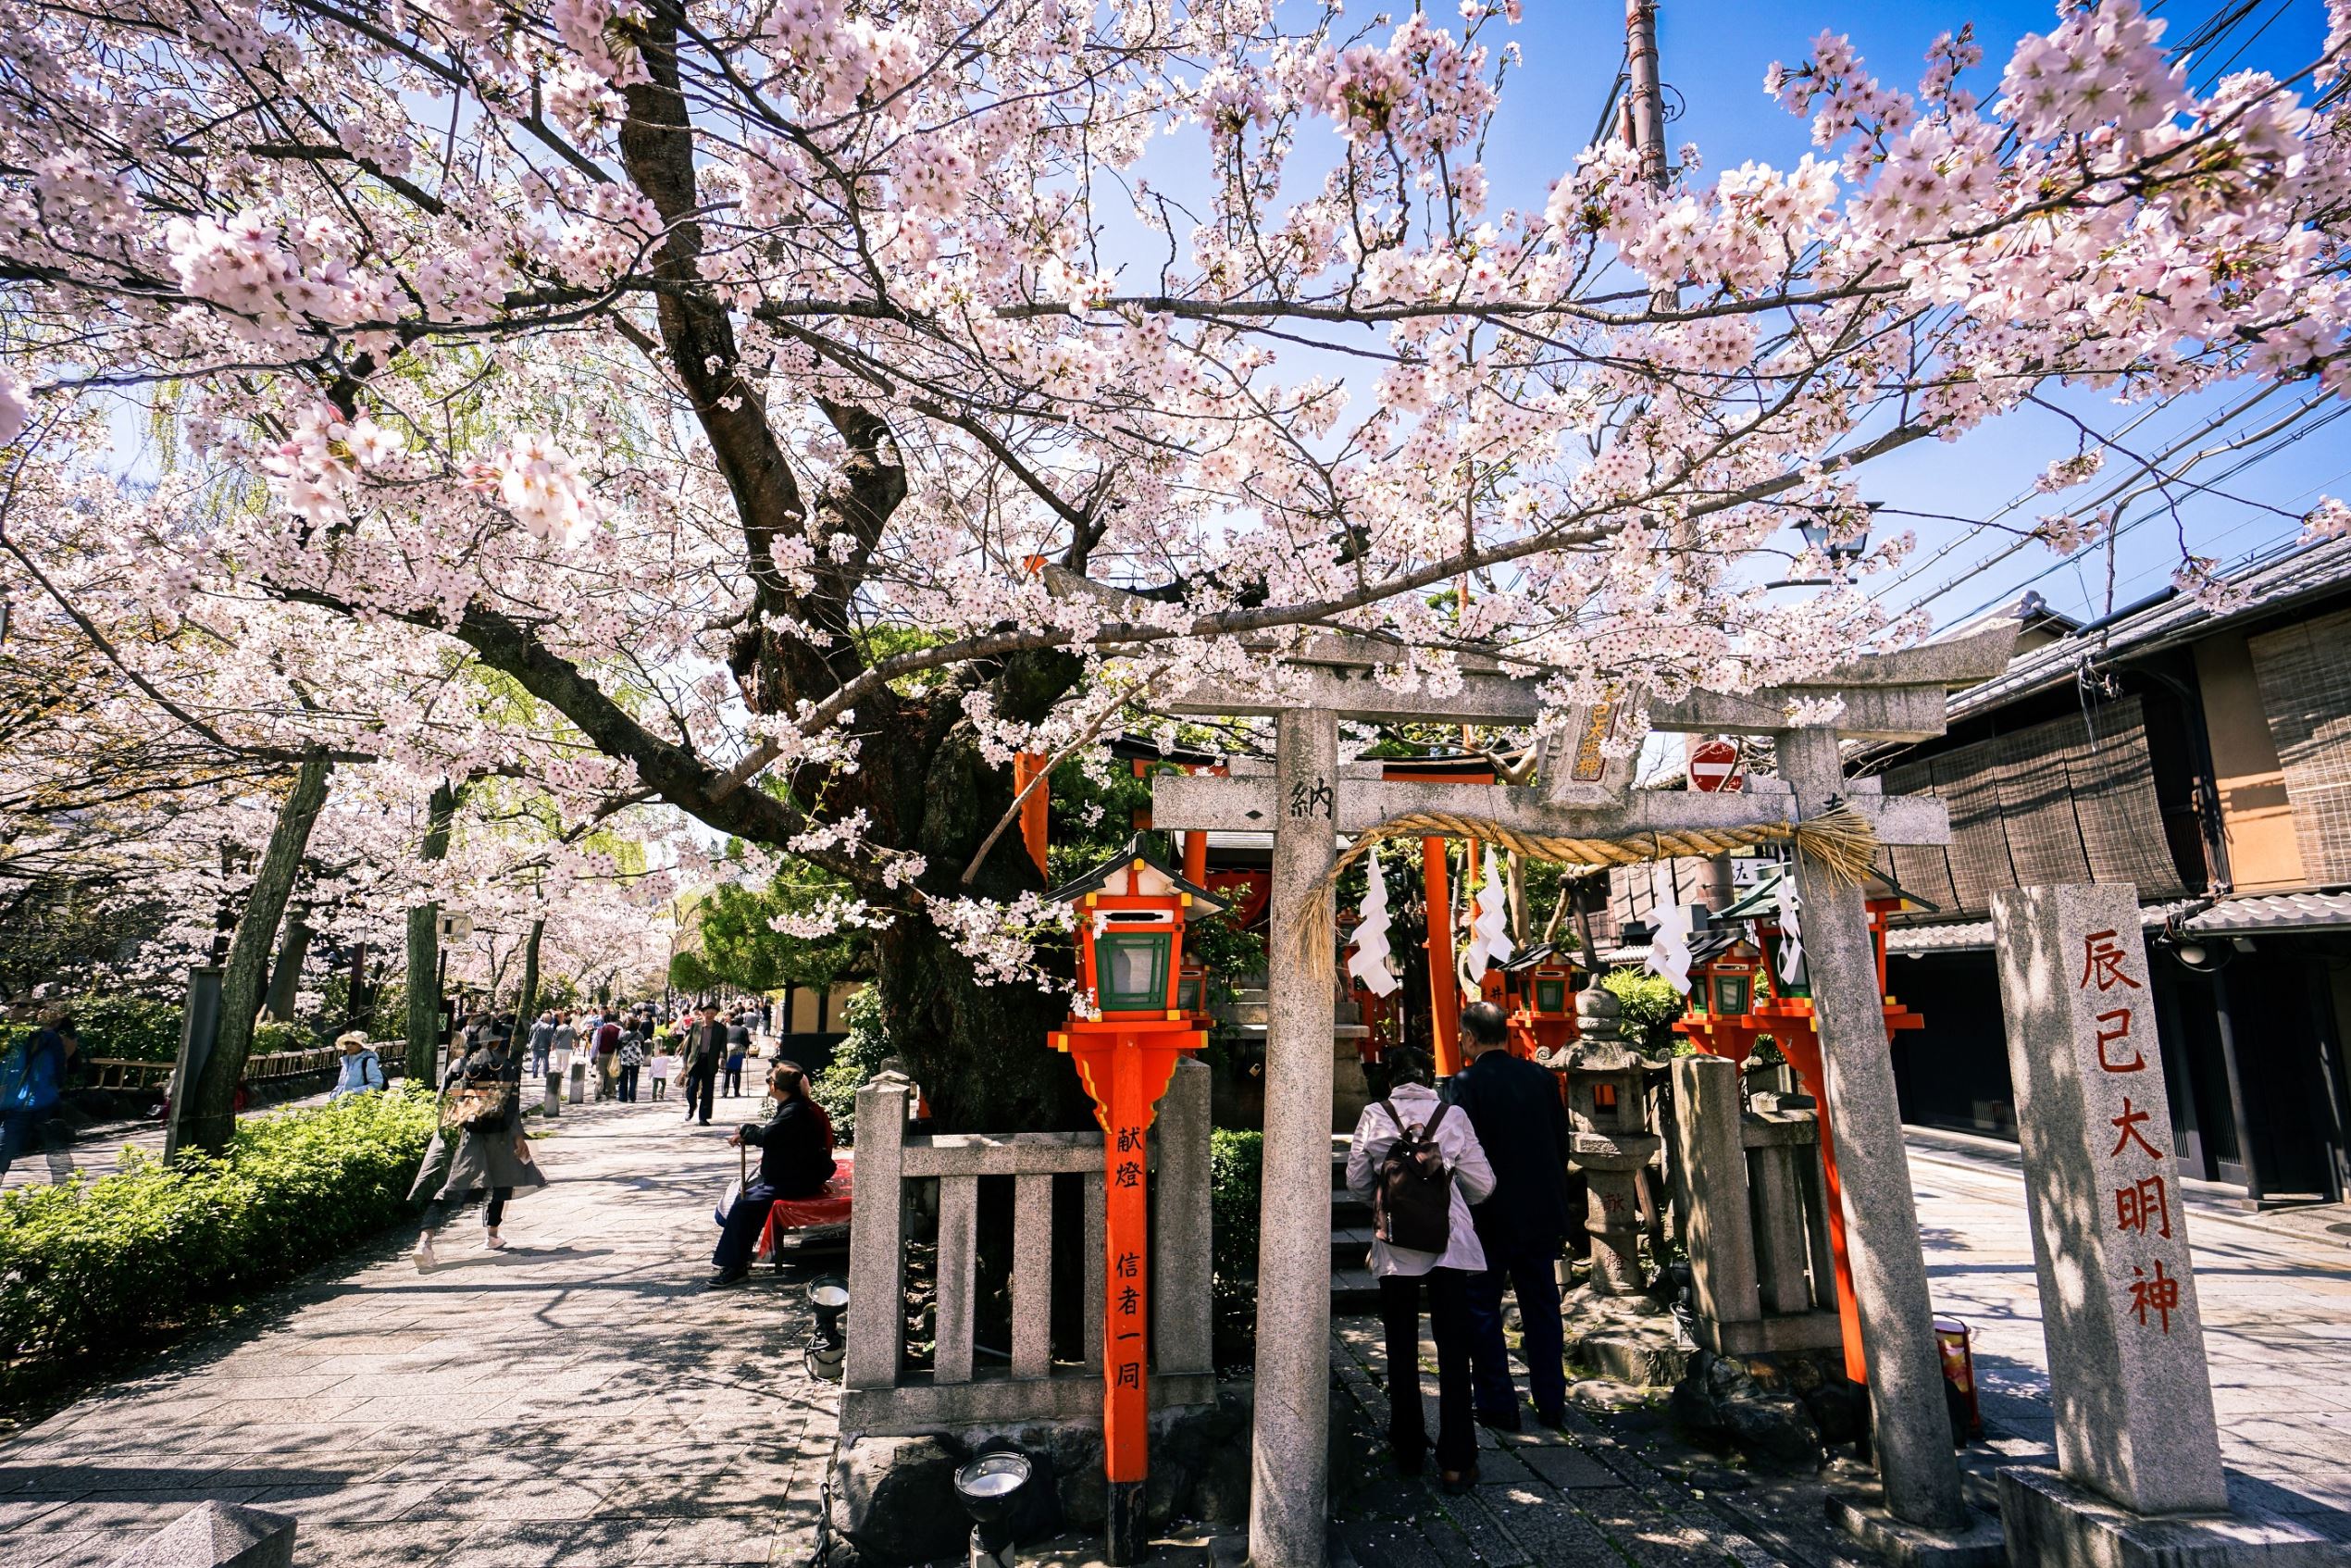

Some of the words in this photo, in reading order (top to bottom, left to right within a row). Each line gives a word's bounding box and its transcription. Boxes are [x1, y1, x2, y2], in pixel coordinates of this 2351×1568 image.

[1290, 778, 1334, 820] 納
[1116, 1251, 1141, 1389] 信者一同
